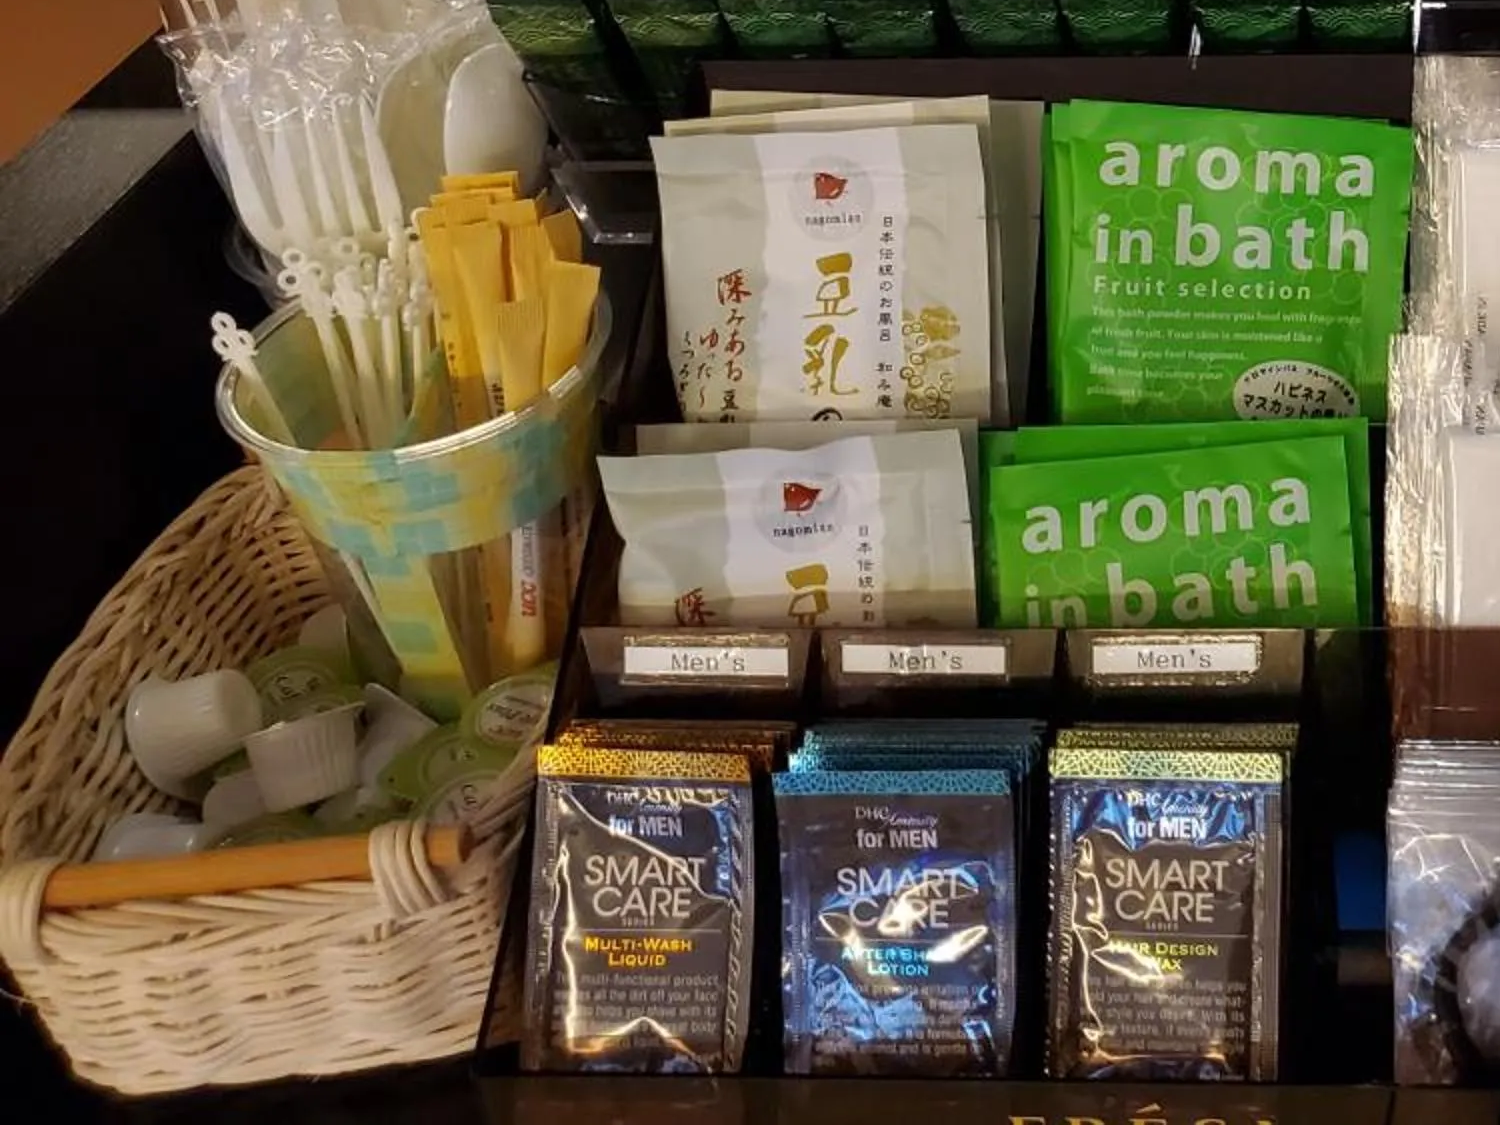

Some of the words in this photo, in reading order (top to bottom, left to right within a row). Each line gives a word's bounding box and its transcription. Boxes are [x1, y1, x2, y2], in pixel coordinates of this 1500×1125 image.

[1099, 139, 1375, 198] aroma
[1093, 213, 1154, 266] in
[1174, 203, 1370, 272] bath
[1093, 275, 1166, 298] Fruit
[1178, 276, 1312, 301] selection
[1022, 477, 1311, 555] aroma
[1025, 583, 1088, 628] in
[1105, 543, 1319, 628] bath
[670, 652, 746, 673] Men's
[888, 651, 964, 672] Men's
[1136, 649, 1213, 670] Men's
[1127, 791, 1161, 807] DHC
[608, 814, 635, 836] for
[638, 816, 683, 837] MEN
[855, 805, 889, 820] DHC
[856, 829, 886, 850] for
[889, 830, 938, 849] MEN
[1127, 816, 1155, 839] for
[1159, 817, 1207, 839] MEN
[585, 854, 706, 886] SMART
[837, 867, 962, 897] SMART
[1105, 858, 1230, 891] SMART
[593, 887, 692, 918] CARE
[849, 897, 951, 928] CARE
[1115, 890, 1215, 923] CARE
[1155, 942, 1219, 957] DESIGN
[868, 963, 929, 976] LOTION
